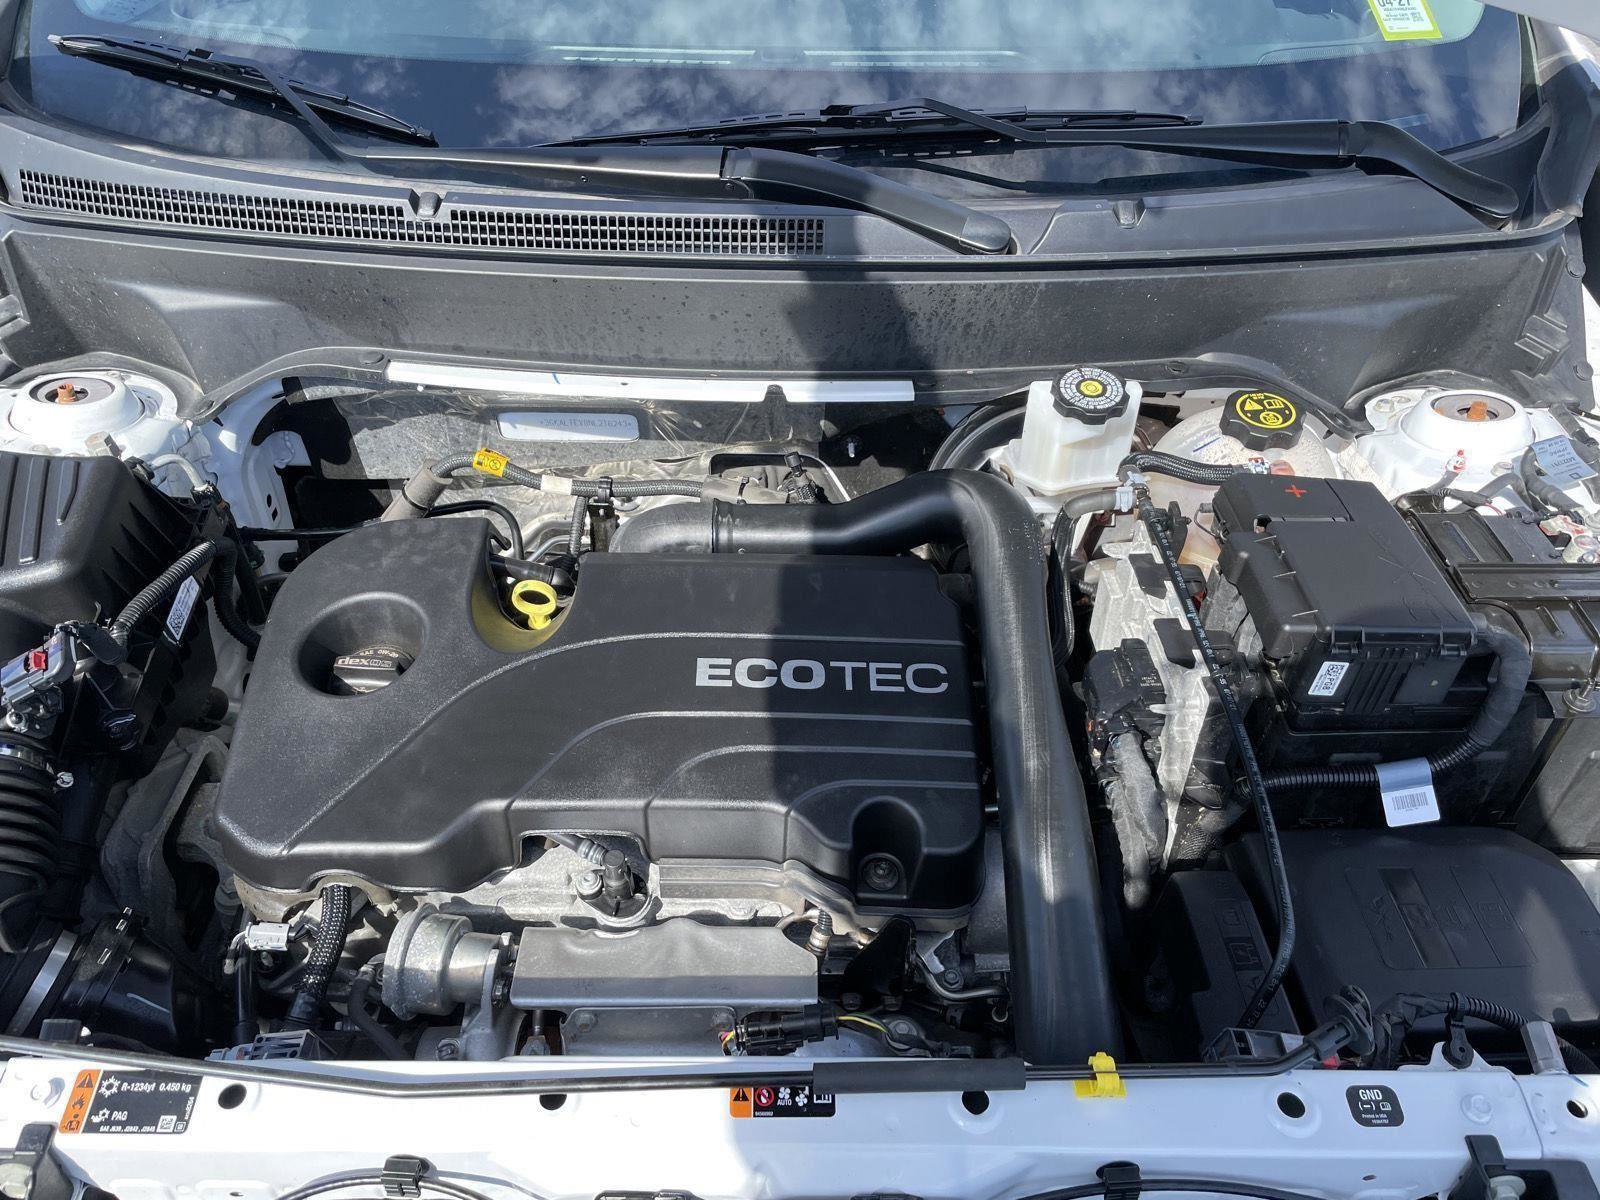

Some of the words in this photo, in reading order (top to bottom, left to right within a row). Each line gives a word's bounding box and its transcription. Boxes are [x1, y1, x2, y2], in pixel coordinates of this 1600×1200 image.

[337, 656, 392, 667] dexos
[695, 657, 949, 694] ECOTEC
[121, 1082, 156, 1093] R-1234yf
[159, 1082, 180, 1092] 0.450
[181, 1082, 192, 1093] kg
[1359, 1089, 1382, 1101] GND
[111, 1110, 128, 1121] PAG
